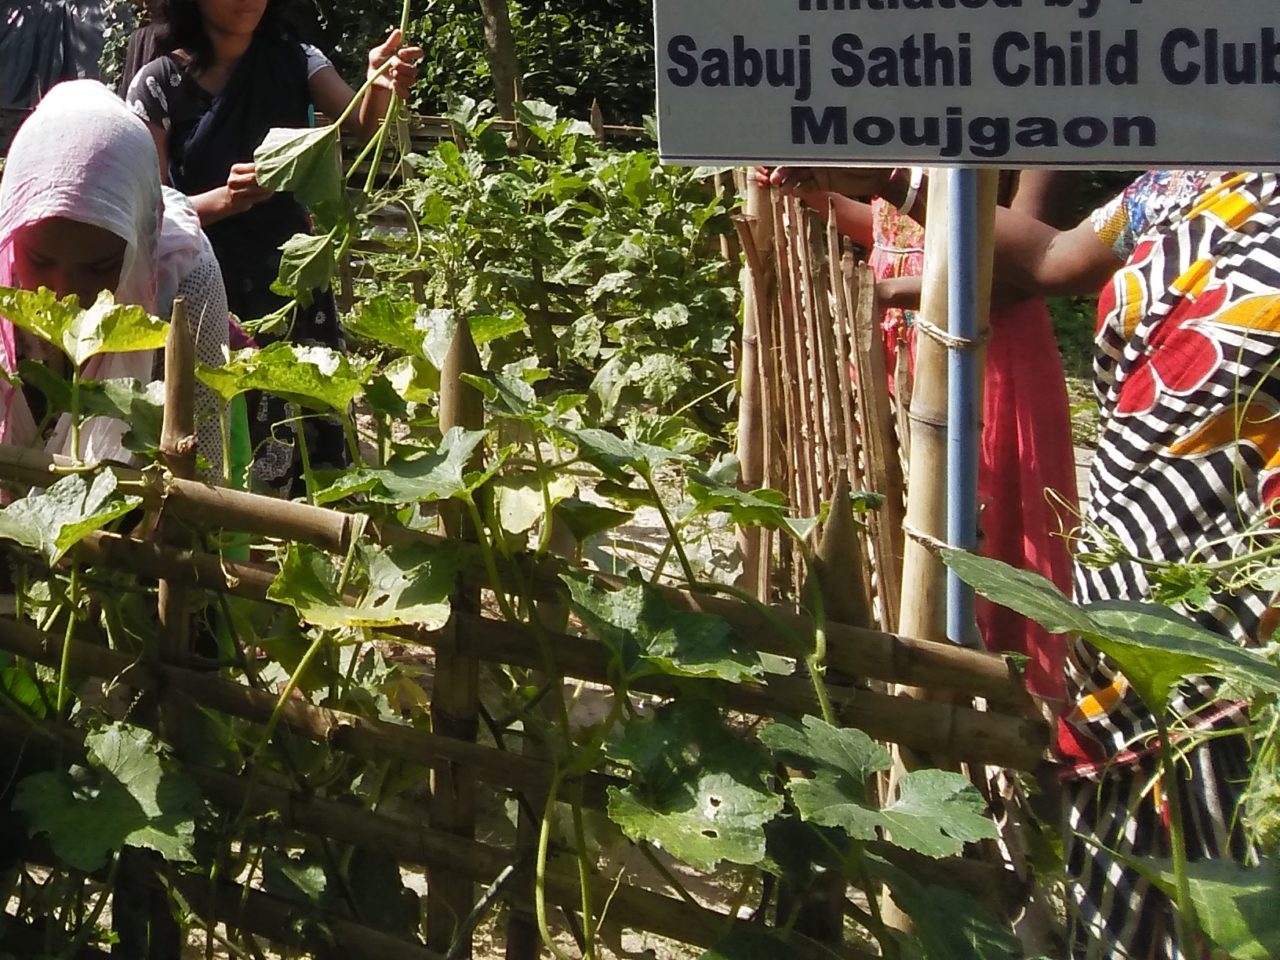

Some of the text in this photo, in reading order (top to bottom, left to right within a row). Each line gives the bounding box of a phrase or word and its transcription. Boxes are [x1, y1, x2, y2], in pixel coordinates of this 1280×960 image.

[667, 34, 812, 101] Sabuj
[831, 32, 971, 87] Sathi
[992, 29, 1138, 87] Child
[791, 106, 1157, 158] Moujgaon
